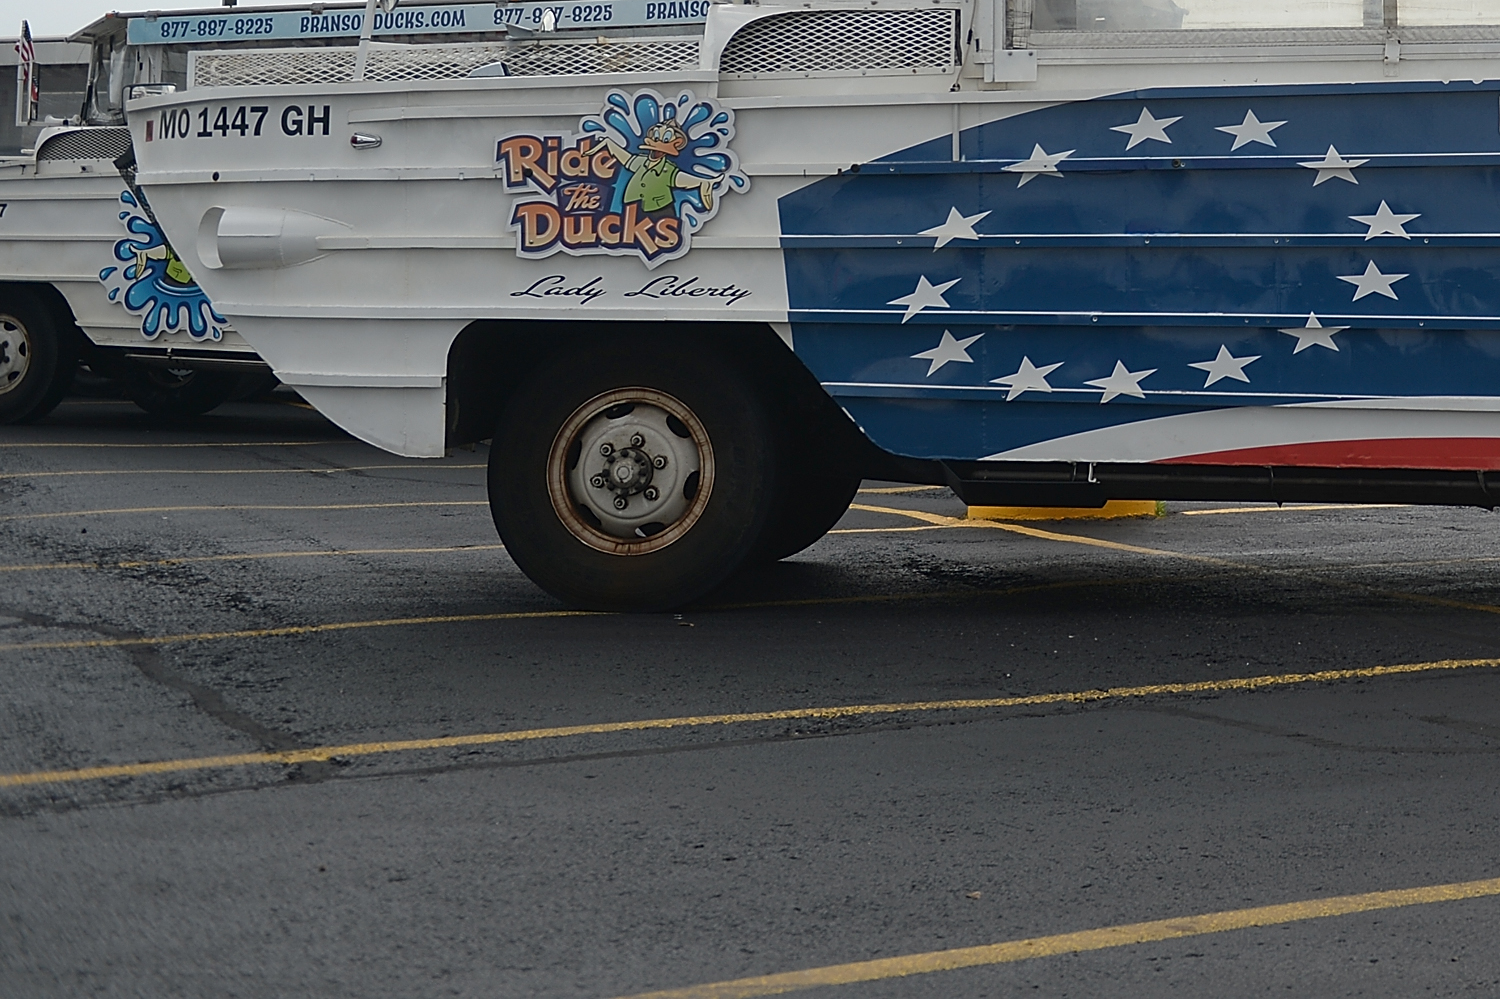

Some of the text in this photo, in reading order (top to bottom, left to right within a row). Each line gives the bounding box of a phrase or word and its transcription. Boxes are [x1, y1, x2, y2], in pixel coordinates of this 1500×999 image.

[161, 17, 273, 38] 877-887-8225
[300, 9, 466, 33] BRANSODUCKS.COM
[493, 4, 613, 25] 877-87-8225
[159, 105, 331, 140] MO 1447 GH
[501, 136, 618, 189] Ride
[517, 203, 679, 255] Ducks
[510, 275, 752, 306] Lady Liberty
